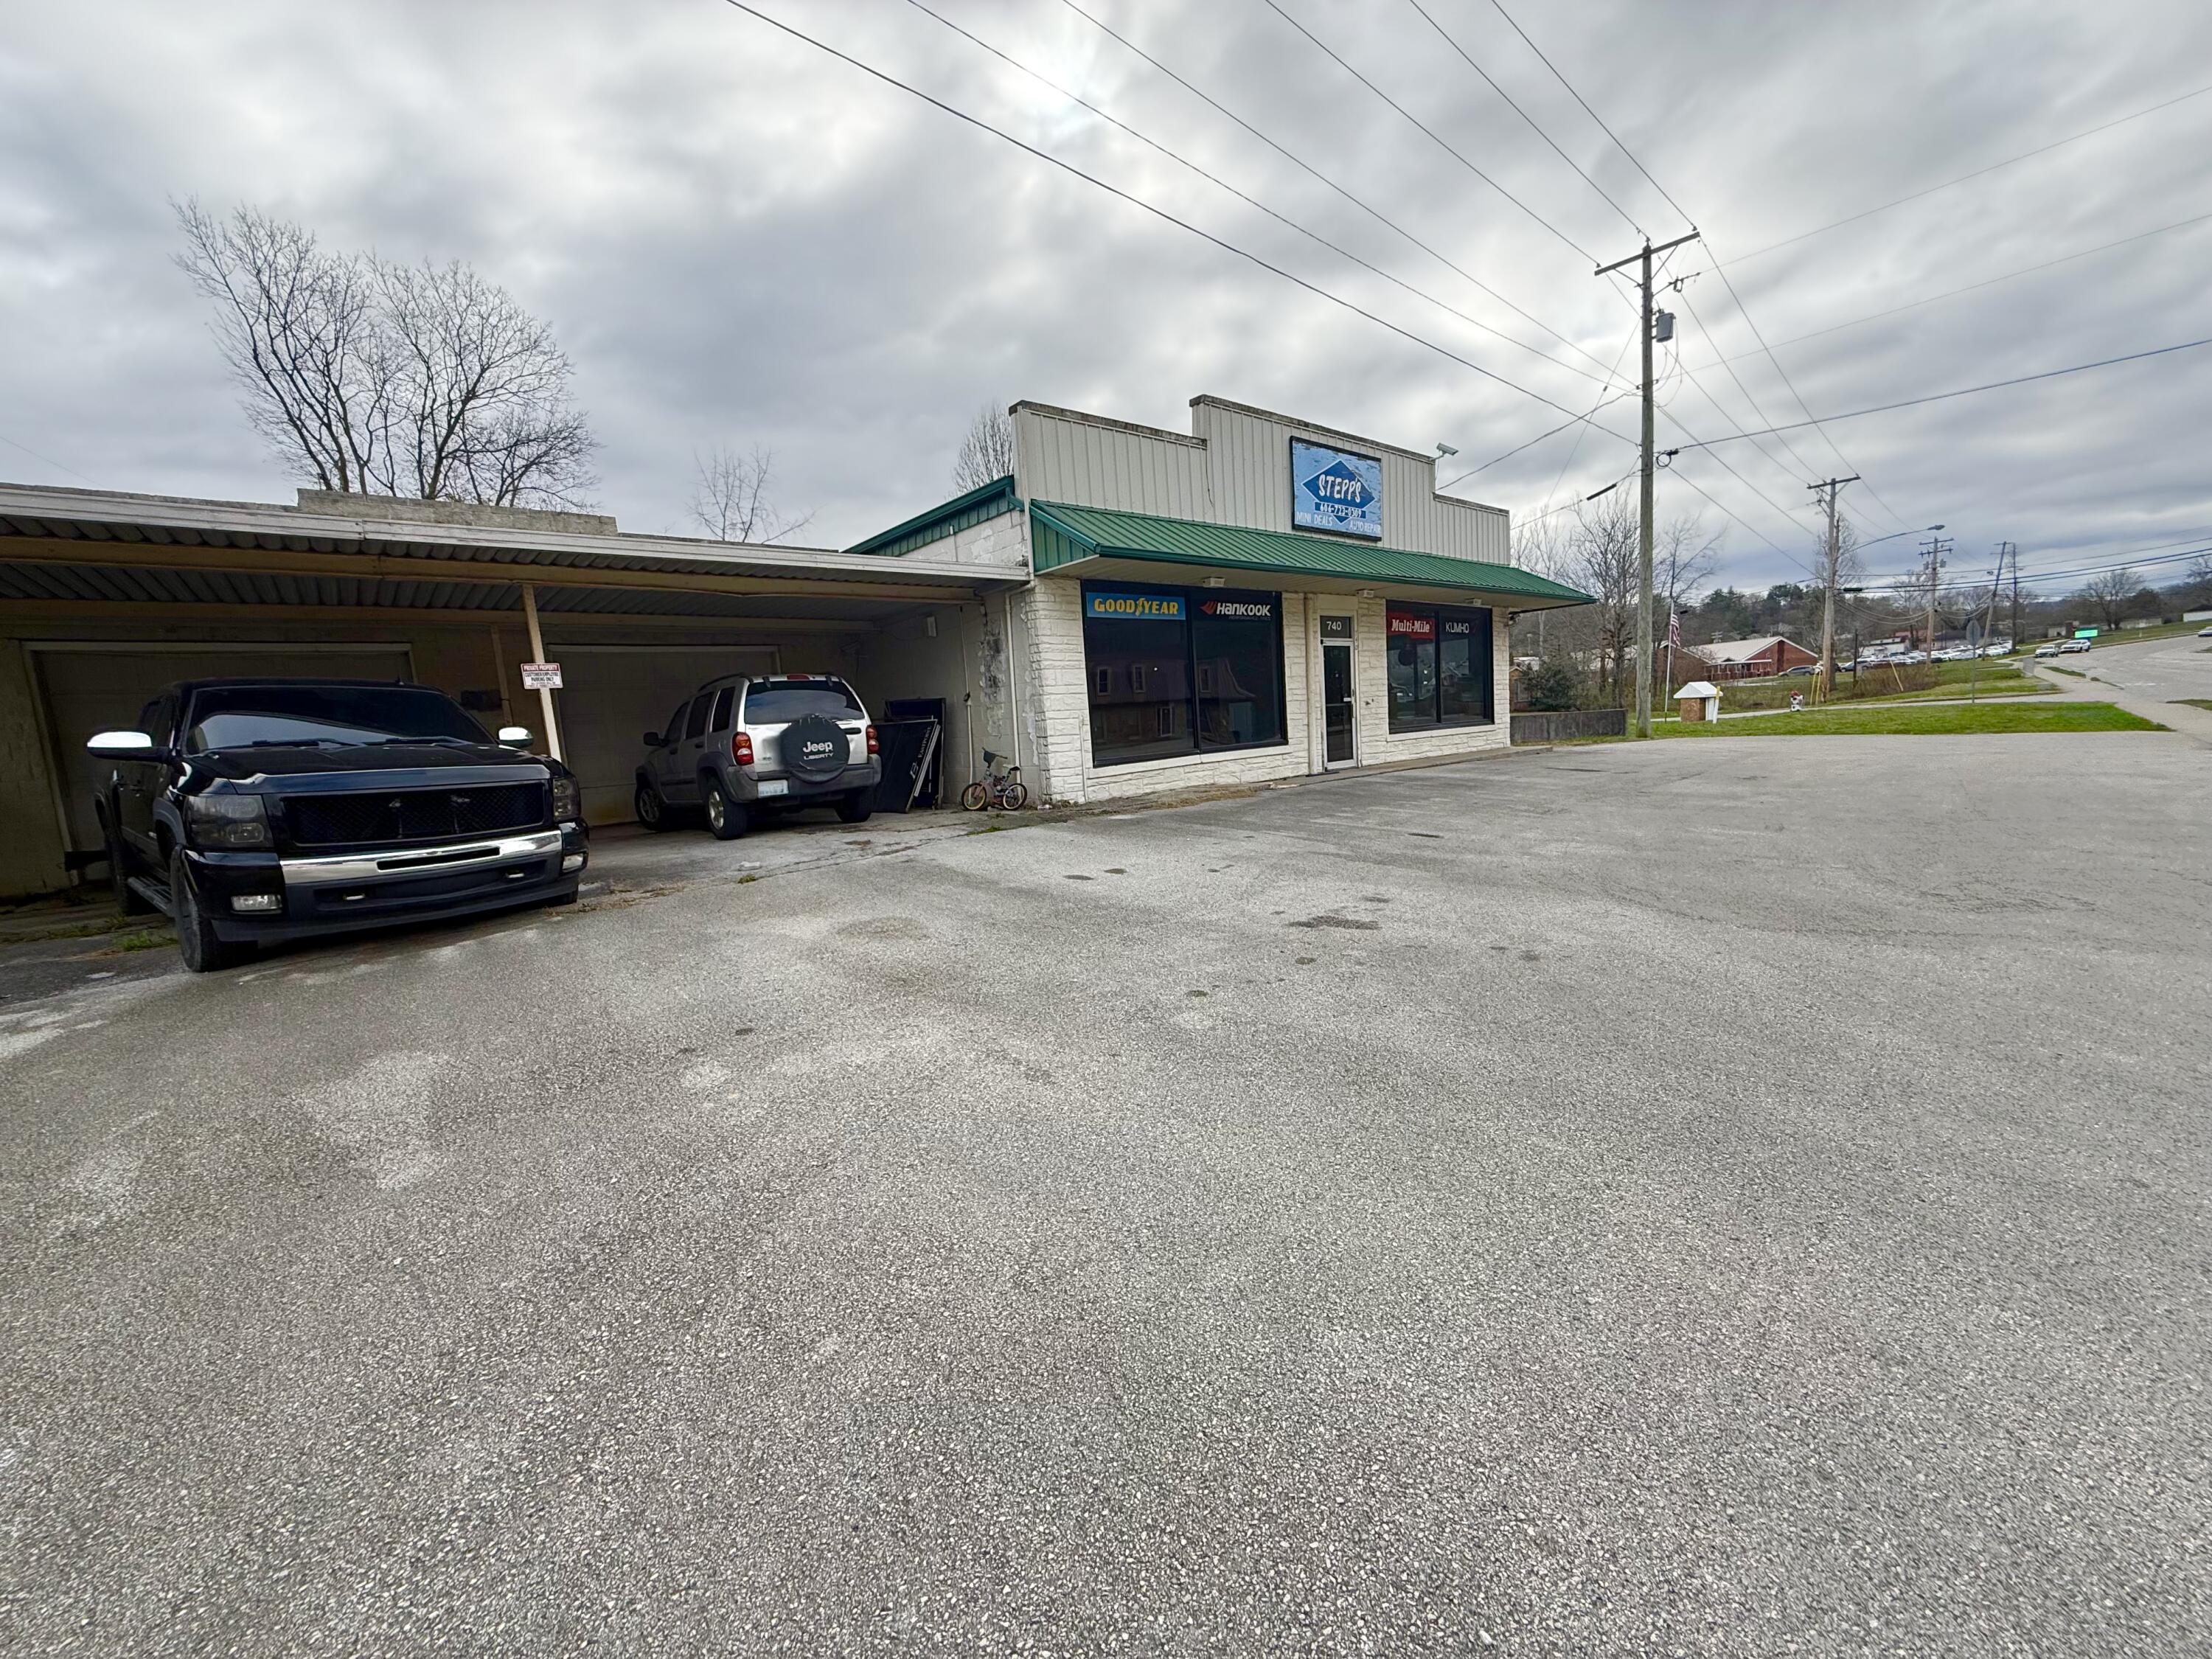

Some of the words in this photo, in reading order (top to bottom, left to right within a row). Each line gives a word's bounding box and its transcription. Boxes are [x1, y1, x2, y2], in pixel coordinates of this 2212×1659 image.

[1318, 474, 1361, 503] STEPP'S
[1296, 512, 1311, 523] MINI
[1314, 514, 1333, 526] DEALS
[1349, 521, 1364, 531] AUTO
[1094, 598, 1178, 616] GOODYEAR
[1326, 621, 1342, 630] 740
[1391, 619, 1430, 633] Multi-Mile
[1446, 622, 1470, 633] KUMHO
[802, 741, 833, 753] Jeep
